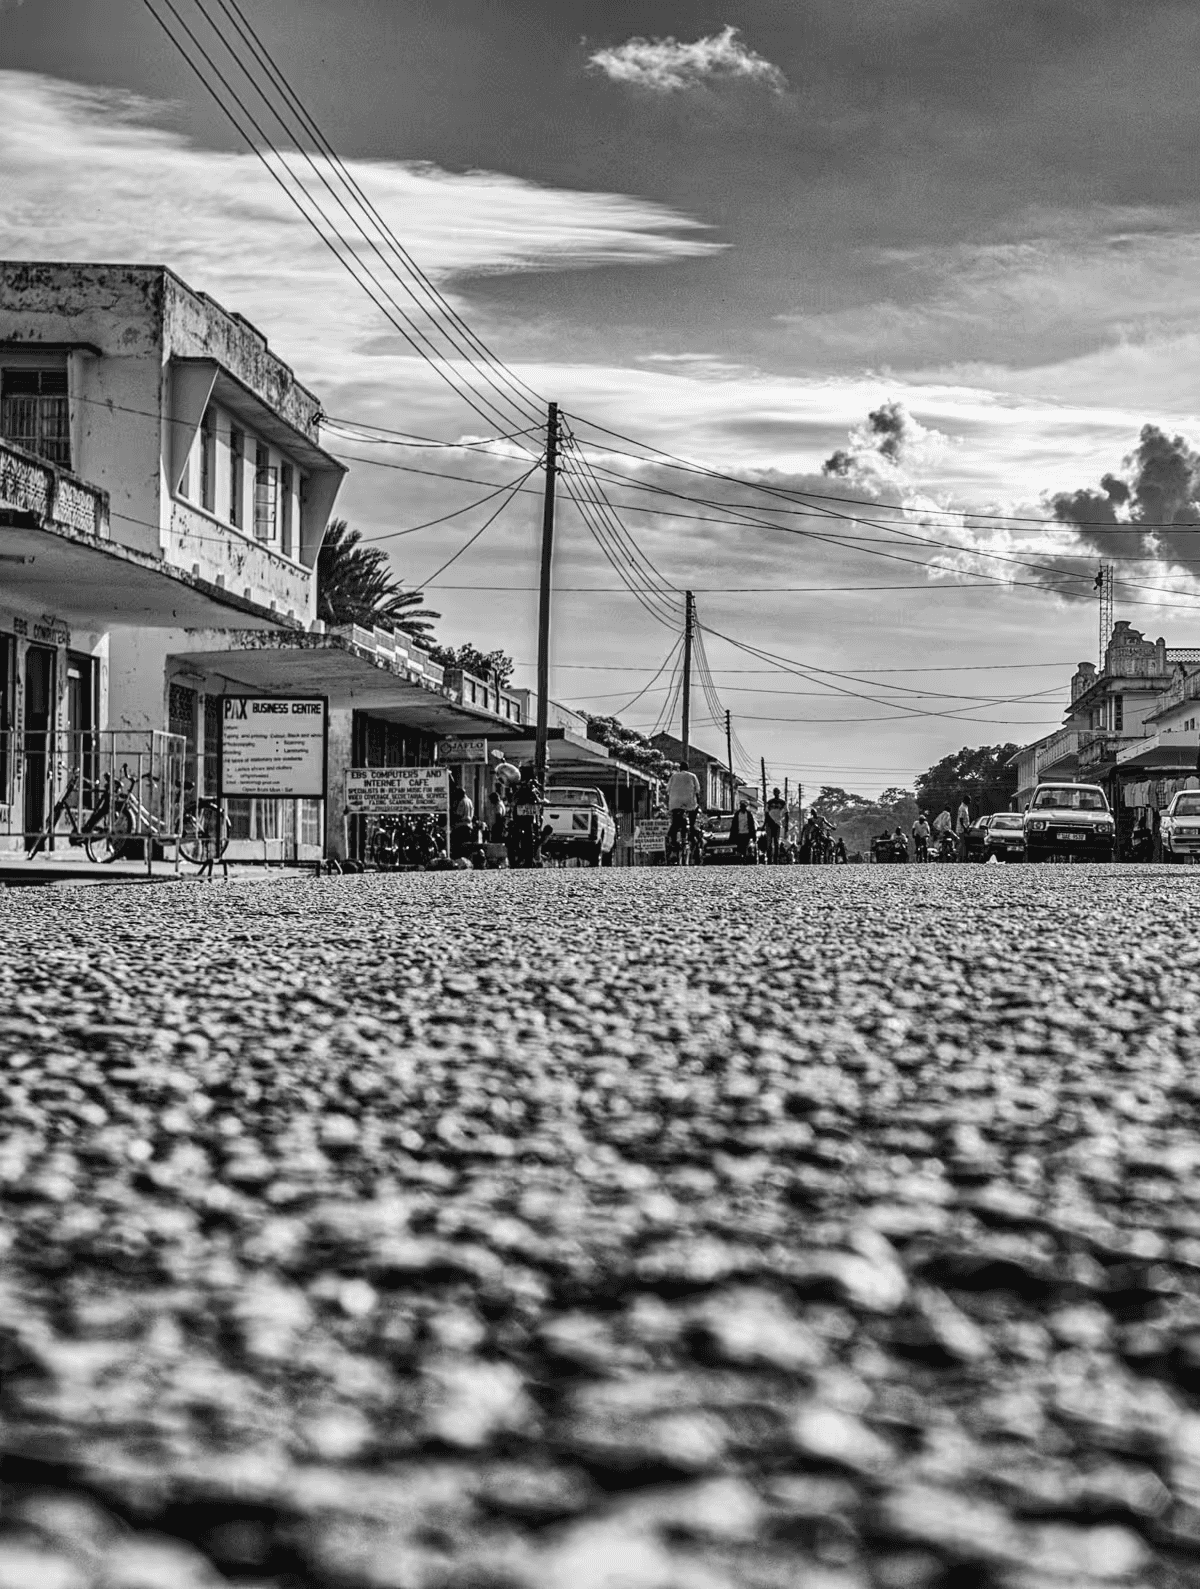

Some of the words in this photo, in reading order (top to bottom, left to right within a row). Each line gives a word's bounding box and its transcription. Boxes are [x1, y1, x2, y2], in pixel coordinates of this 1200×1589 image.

[224, 699, 248, 720] PAX
[252, 703, 289, 714] BUSINESS
[291, 703, 322, 714] CENTRE
[351, 771, 367, 779] EBS
[371, 771, 419, 779] COMPUTERS
[426, 770, 442, 778] AND
[364, 779, 401, 787] INTERNET
[409, 778, 429, 787] CAFE
